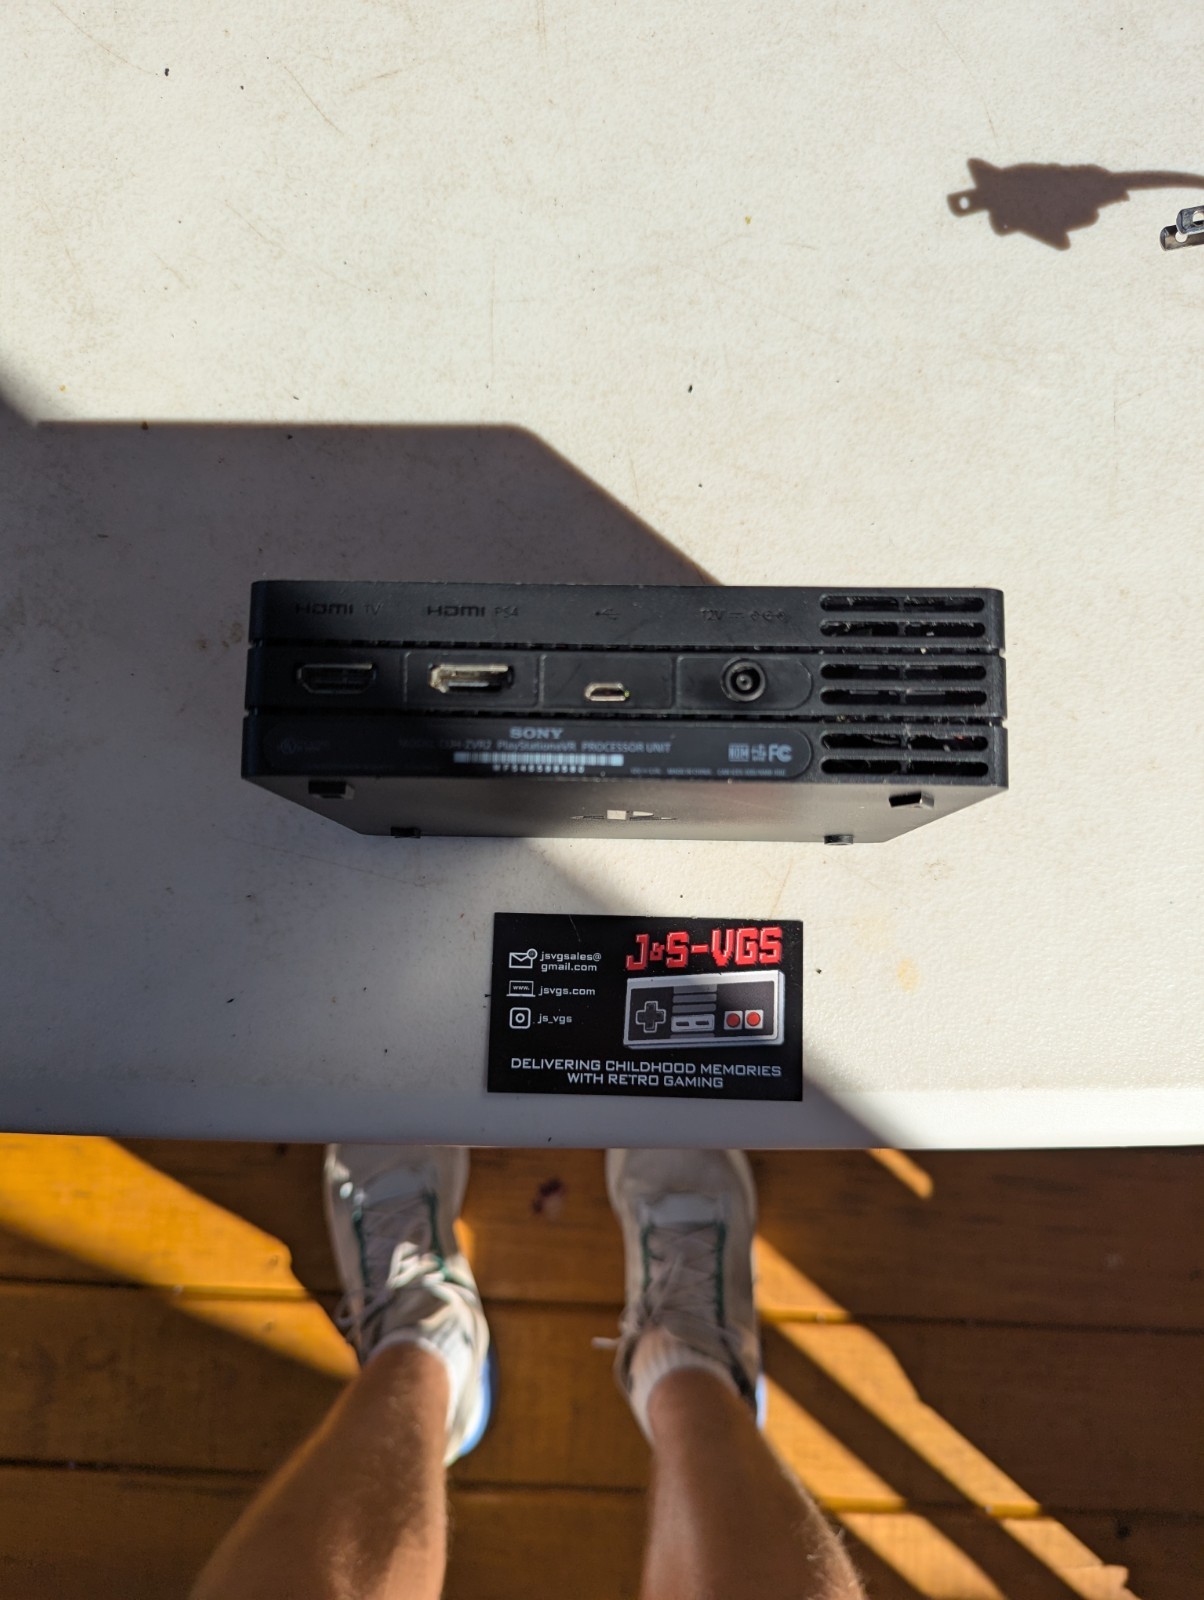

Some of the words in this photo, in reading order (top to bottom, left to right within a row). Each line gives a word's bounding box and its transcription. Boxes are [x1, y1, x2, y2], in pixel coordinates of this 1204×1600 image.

[296, 603, 354, 616] HDMI
[364, 604, 380, 615] TV
[427, 605, 485, 617] HDMI
[495, 606, 519, 618] PS4
[509, 726, 564, 740] SONY
[581, 742, 644, 753] PROCESSOR
[645, 743, 672, 754] UNIT
[626, 926, 783, 971] J&S-VGS
[540, 951, 602, 962] jsvgsales@
[541, 962, 597, 972] gmail.com
[538, 986, 596, 997] jsvgs.com
[537, 1013, 573, 1024] js_vgs
[511, 1057, 601, 1071] DELIVERING
[605, 1060, 696, 1074] CHILDHOOD
[701, 1063, 782, 1077] MEMORIES
[567, 1072, 604, 1085] WITH
[608, 1074, 659, 1086] RETRO
[664, 1076, 724, 1089] GAMING
